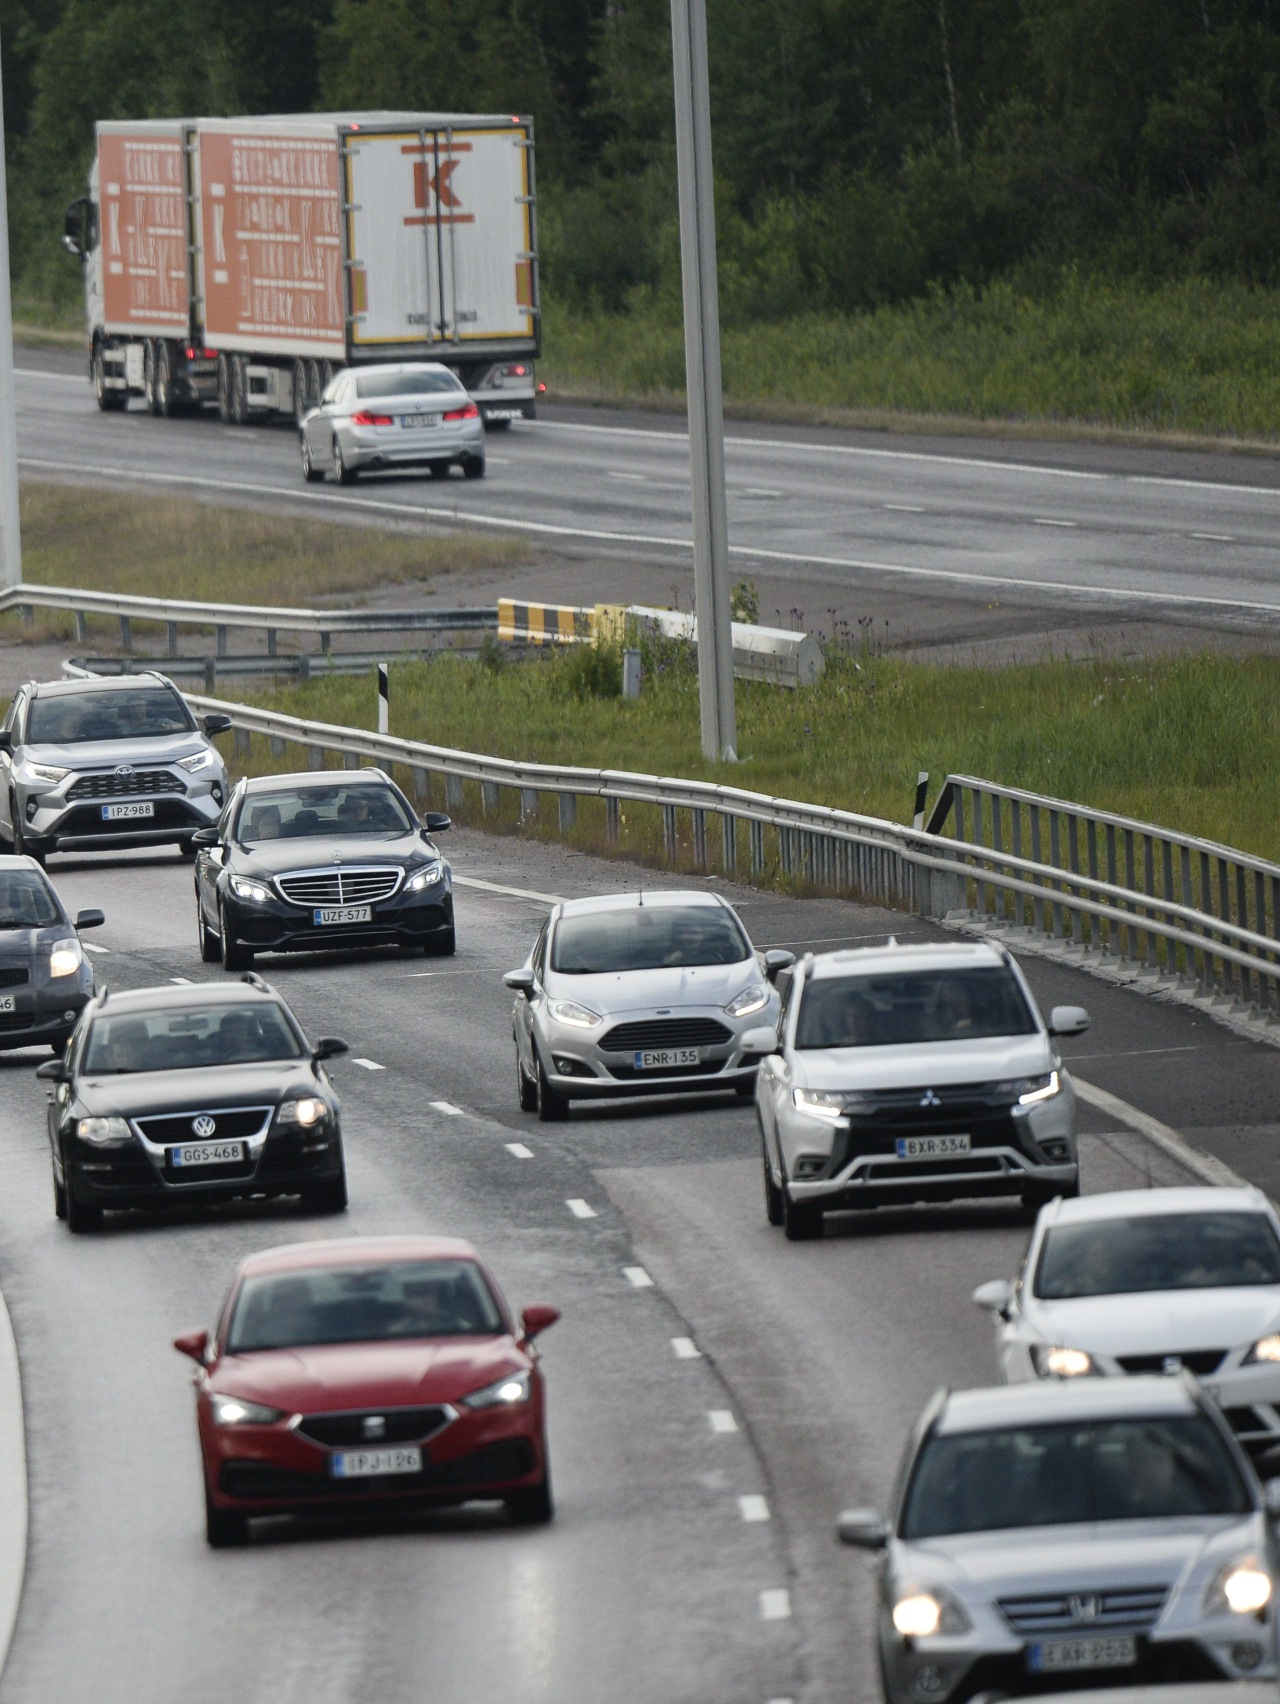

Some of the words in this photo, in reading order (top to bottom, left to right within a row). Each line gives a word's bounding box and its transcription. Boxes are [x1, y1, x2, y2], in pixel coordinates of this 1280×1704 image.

[413, 159, 463, 209] K
[112, 805, 151, 817] IPZ-988
[323, 909, 368, 922] UZF-577
[644, 1050, 697, 1066] ENR-135
[184, 1145, 239, 1161] GGS-468
